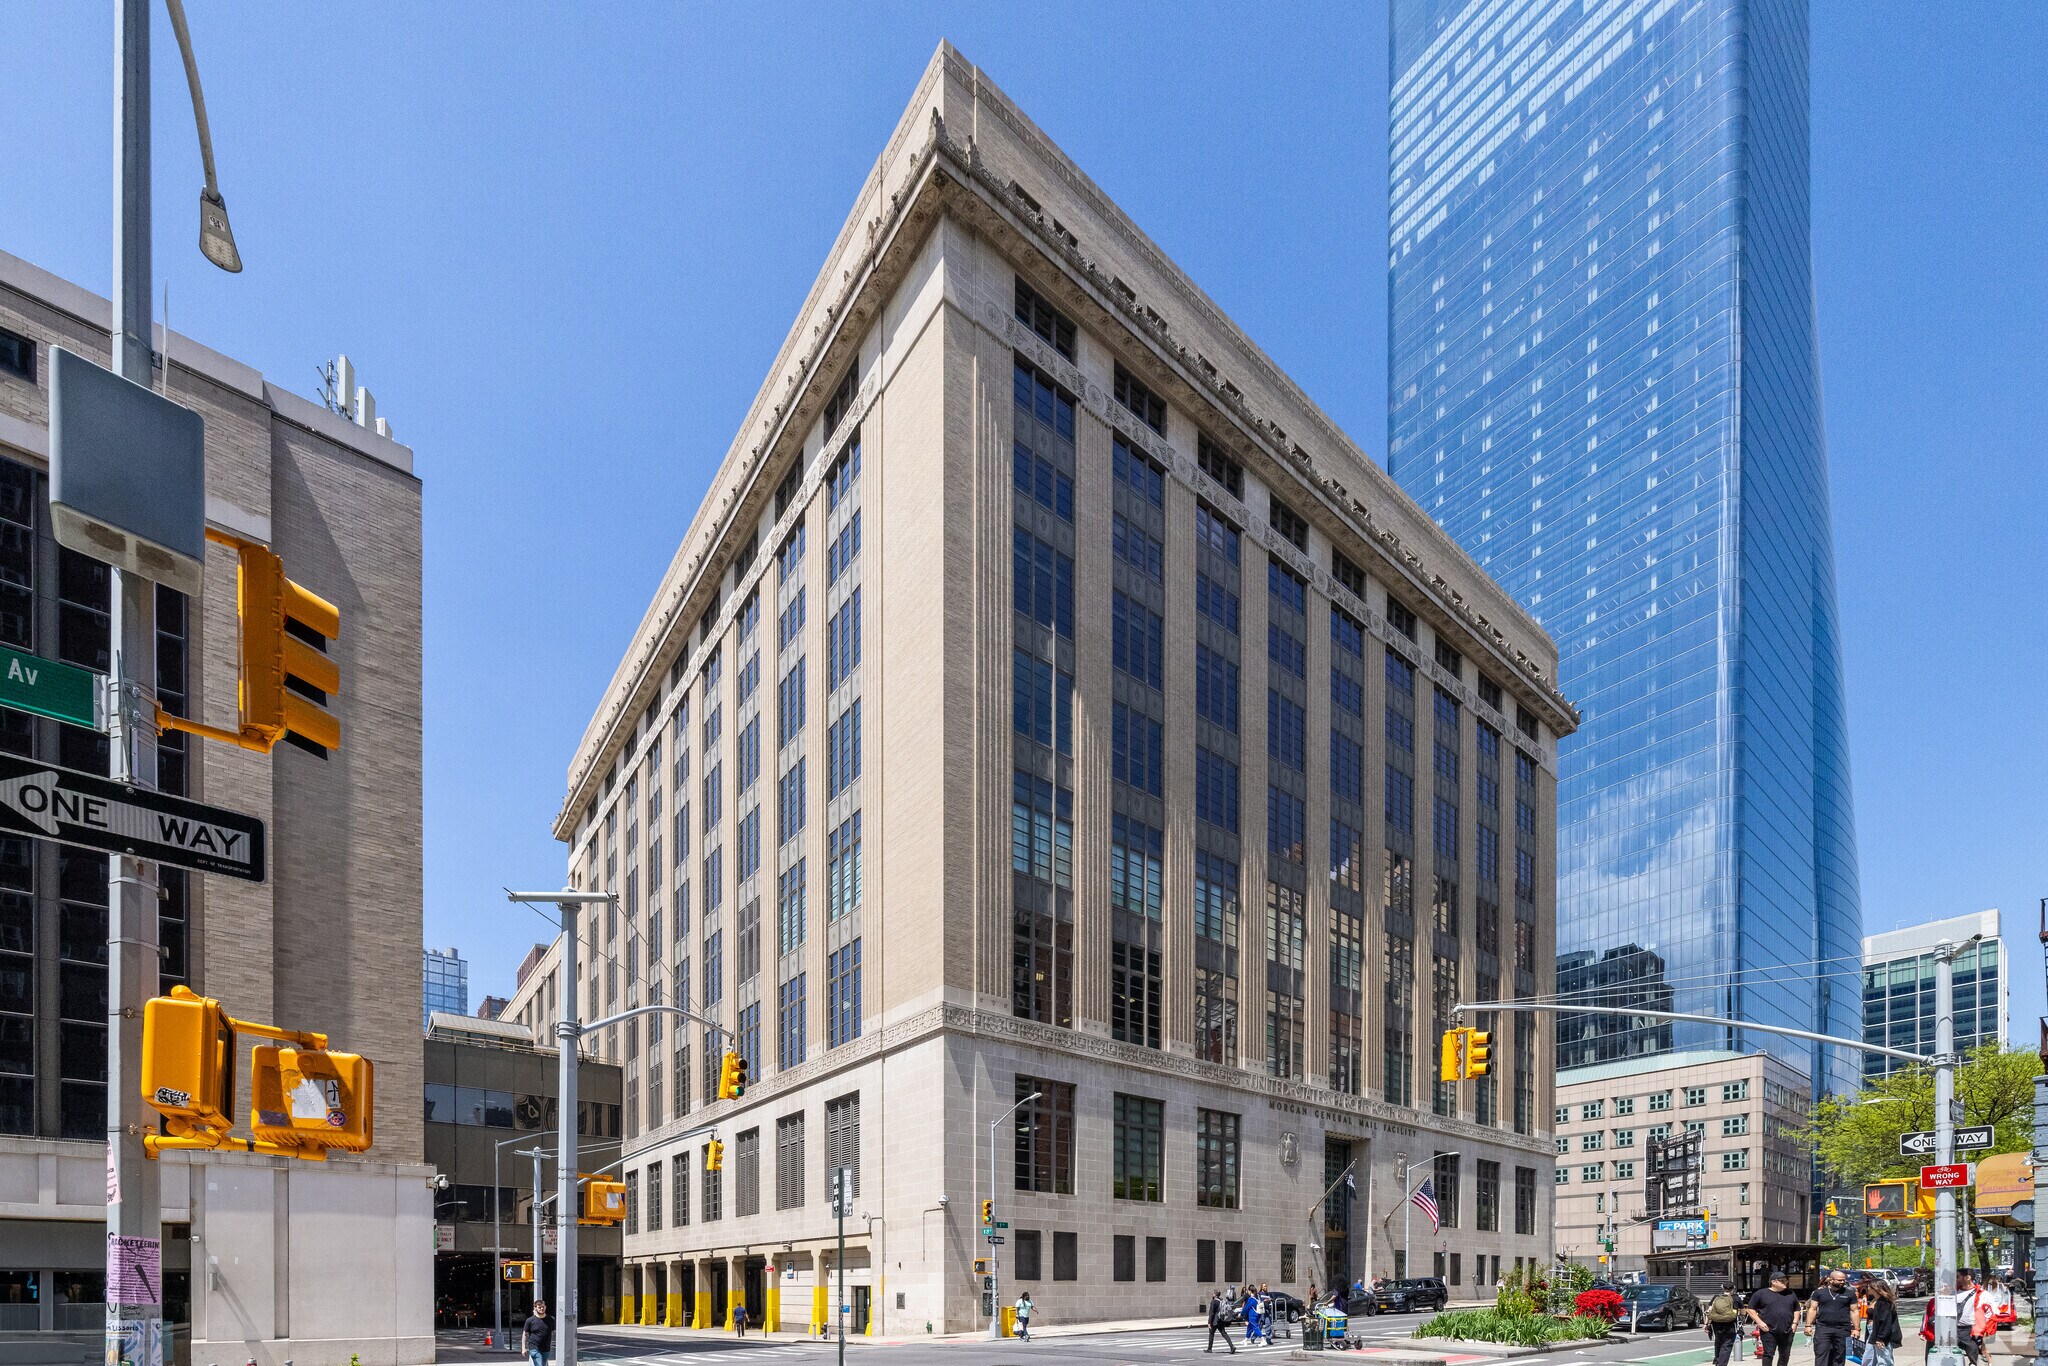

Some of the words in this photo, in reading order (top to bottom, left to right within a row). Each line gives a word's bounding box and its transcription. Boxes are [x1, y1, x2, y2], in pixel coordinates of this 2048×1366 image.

[8, 658, 38, 686] Av
[19, 784, 108, 828] ONE
[158, 815, 241, 856] WAY
[1250, 1074, 1289, 1096] UNITED
[1295, 1083, 1327, 1104] STATES
[1333, 1092, 1364, 1113] PARCEL
[1370, 1100, 1393, 1118] POST
[1269, 1100, 1308, 1116] MORGAN
[1314, 1109, 1352, 1125] GENERAL
[1359, 1118, 1378, 1130] MAIL
[1383, 1123, 1417, 1138] FACILITY
[1954, 1132, 1984, 1143] WAY
[1929, 1172, 1960, 1180] WRONG
[1674, 1221, 1704, 1230] PARK
